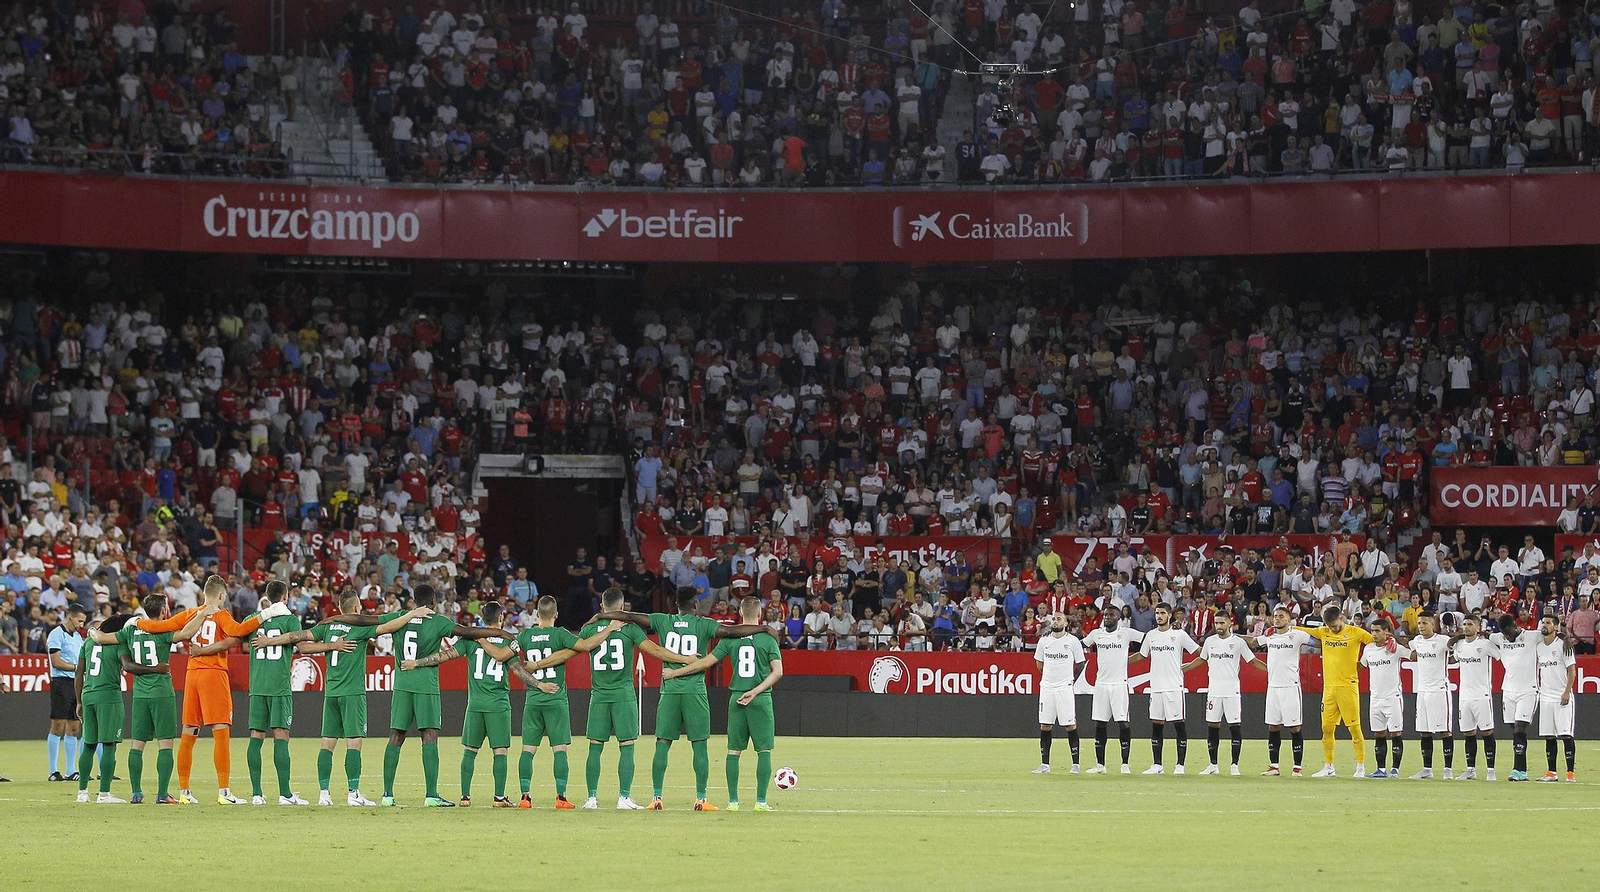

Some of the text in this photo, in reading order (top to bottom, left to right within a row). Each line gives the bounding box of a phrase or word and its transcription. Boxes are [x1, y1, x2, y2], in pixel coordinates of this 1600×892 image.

[259, 192, 306, 203] DESDE
[203, 194, 420, 249] Cruzcampo
[621, 208, 744, 238] betfair
[948, 213, 1074, 239] CaixaBank
[89, 645, 103, 676] 5
[132, 640, 159, 667] 13
[403, 631, 418, 661] 6
[593, 638, 625, 671] 23
[11, 658, 49, 668] DESDE
[474, 648, 504, 681] 14
[738, 645, 756, 678] 8
[916, 664, 1033, 695] Playtika
